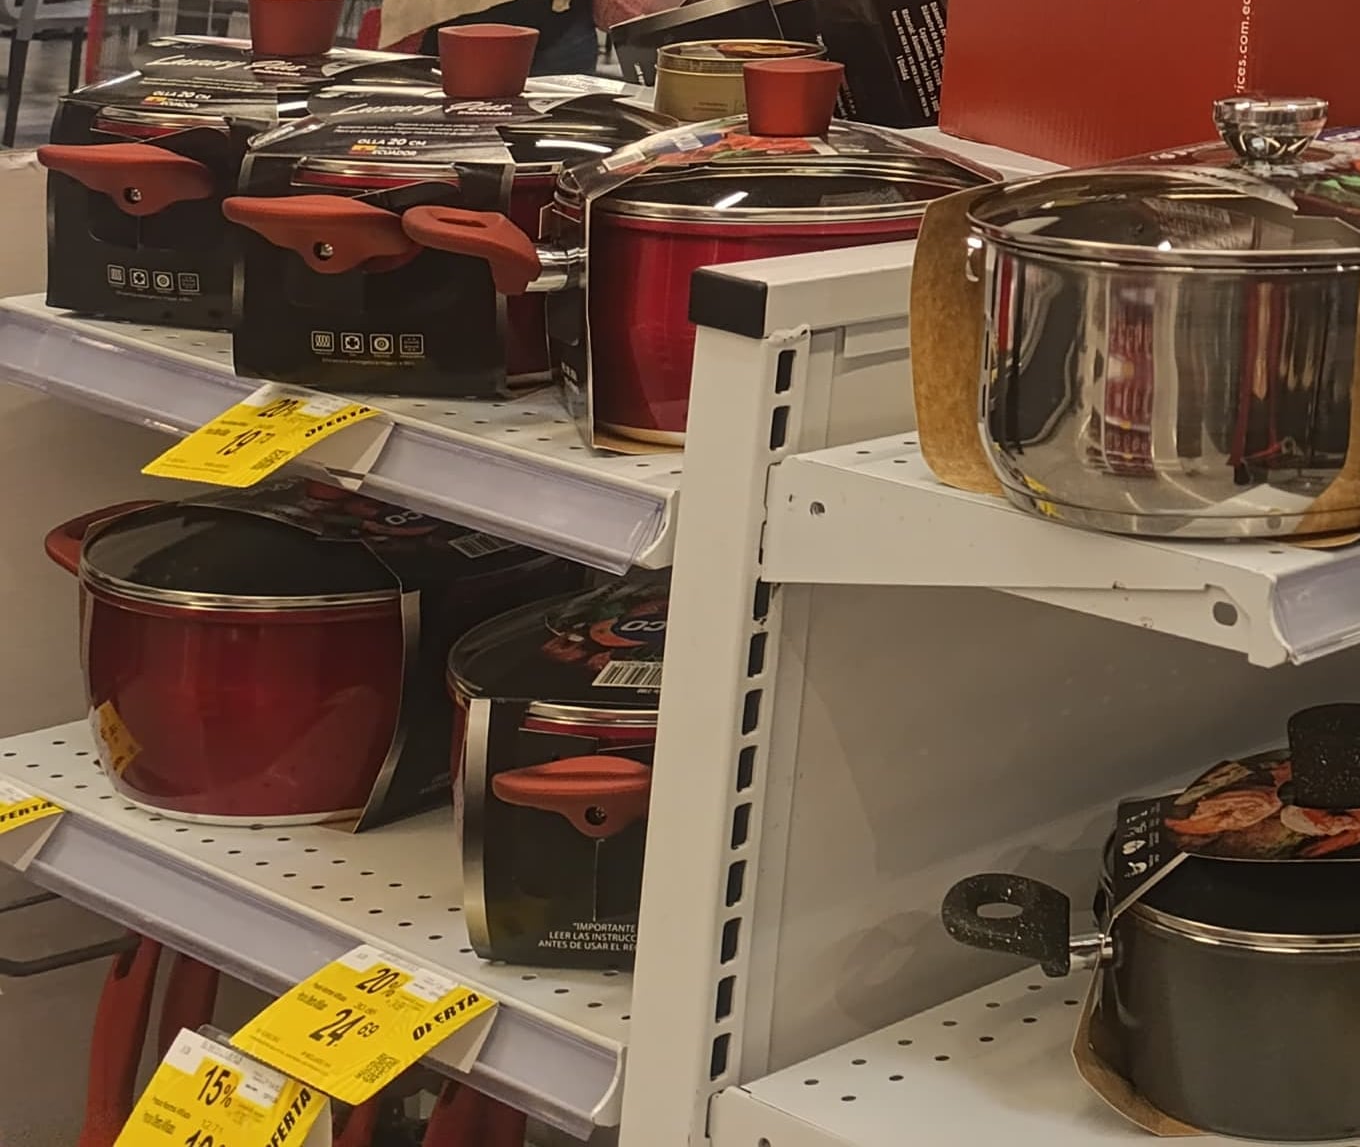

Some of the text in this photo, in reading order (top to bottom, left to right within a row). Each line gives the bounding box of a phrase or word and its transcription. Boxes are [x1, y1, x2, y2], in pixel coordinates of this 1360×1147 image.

[145, 54, 247, 73] Luxury
[152, 90, 176, 98] OLLA
[177, 90, 196, 99] 20
[330, 100, 513, 117] Luxury Plus
[386, 137, 408, 146] 20
[538, 939, 621, 951] ANTES DE USAR EL
[549, 931, 637, 942] LEER LAS INSTRUCC
[412, 993, 480, 1042] OFERTA
[308, 1008, 366, 1047] 24
[197, 1064, 237, 1108] 15%
[265, 1087, 313, 1147] FERTA
